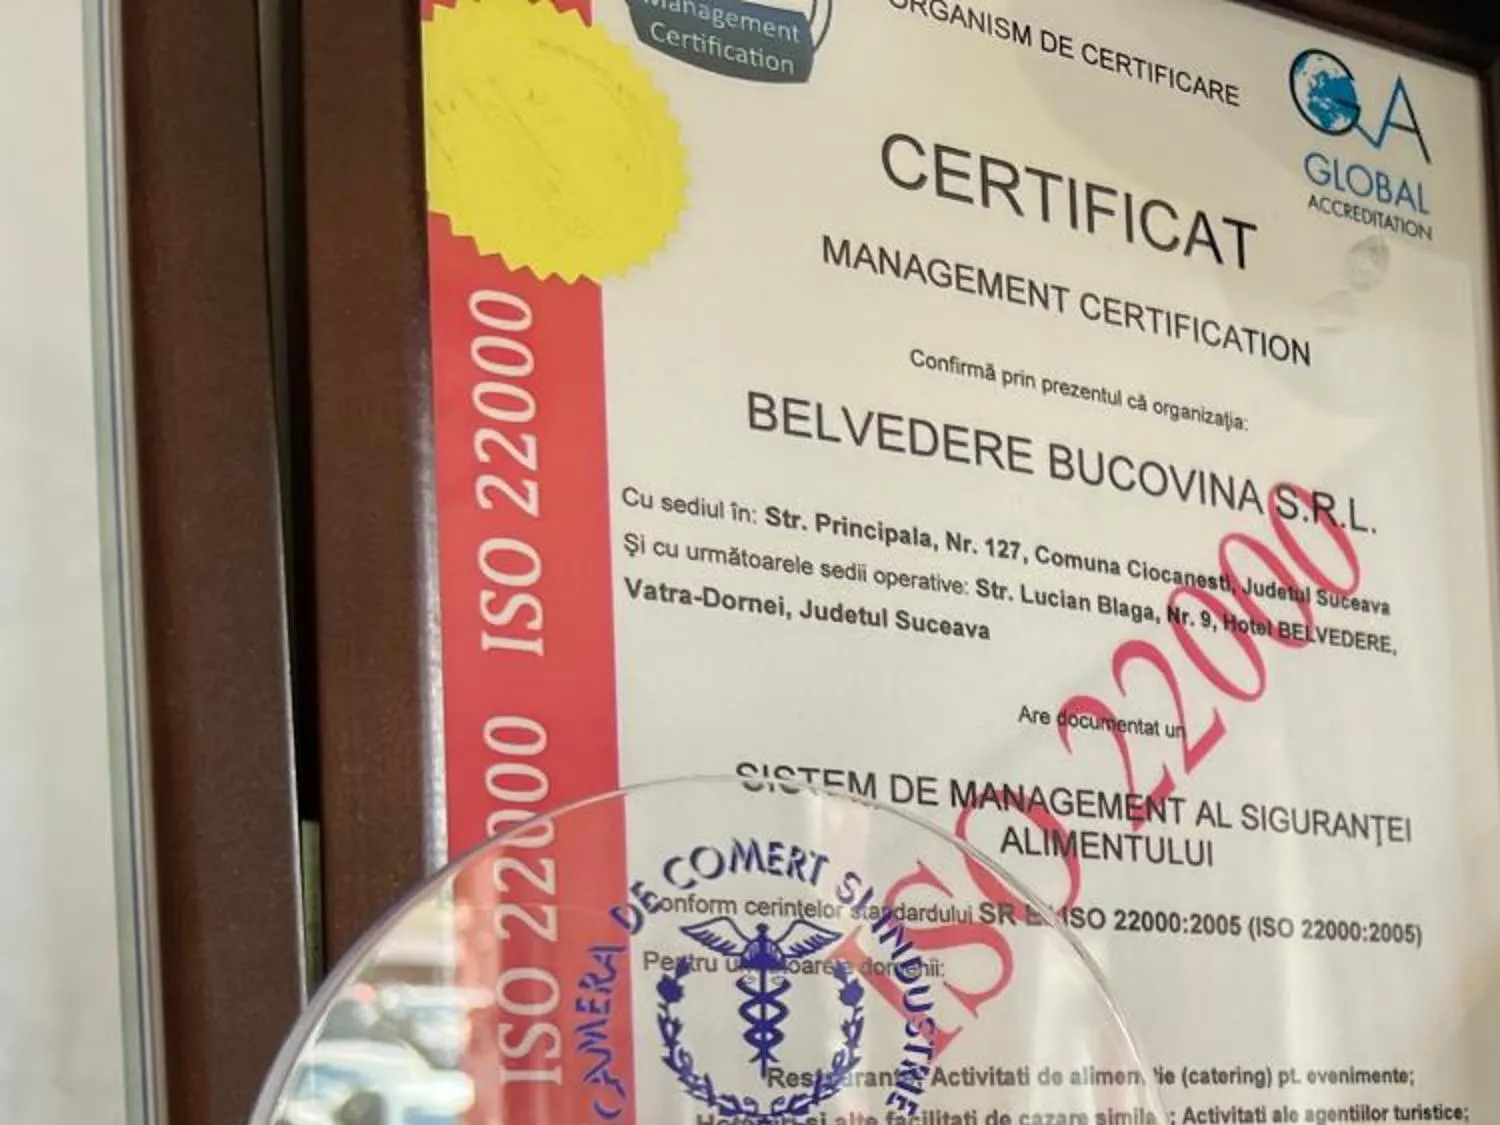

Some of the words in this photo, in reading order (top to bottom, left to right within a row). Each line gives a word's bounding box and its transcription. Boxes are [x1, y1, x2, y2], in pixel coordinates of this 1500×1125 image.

[650, 21, 796, 76] Certification
[1040, 29, 1074, 59] DE
[1082, 42, 1241, 107] CERTIFICARE
[881, 132, 1258, 270] CERTIFICAT
[1303, 152, 1431, 216] GLOBAL
[1307, 195, 1434, 242] ACCREDITATION
[822, 234, 1070, 313] MANAGEMENT
[1080, 291, 1312, 367] CERTIFICATION
[468, 287, 542, 520] 22000
[909, 348, 995, 382] Confirmă
[1001, 368, 1036, 390] prin
[1041, 378, 1122, 407] prezentul
[1126, 393, 1148, 412] că
[747, 390, 1034, 476] BELVEDERE
[1048, 442, 1265, 515] BUCOVINA
[1275, 482, 1378, 535] S.R.L.
[620, 486, 653, 510] Cu
[660, 495, 725, 520] sediul
[764, 506, 809, 531] Str.
[815, 512, 939, 551] Principala,
[945, 531, 978, 555] Nr.
[984, 539, 1029, 565] 127,
[1034, 545, 1121, 576] Comuna
[1242, 577, 1310, 604] Judetul
[1315, 590, 1391, 616] Suceava
[479, 533, 545, 658] ISO
[624, 577, 793, 621] Vatra-Dornei,
[798, 599, 889, 629] Judetul
[894, 608, 991, 641] Suceava
[652, 540, 679, 559] cu
[686, 544, 814, 576] următoarele
[819, 559, 868, 583] sedii
[873, 568, 969, 596] operative:
[975, 576, 1014, 602] Str.
[1019, 583, 1091, 613] Lucian
[1098, 597, 1161, 626] Blaga,
[1166, 606, 1195, 628] Nr.
[1199, 611, 1218, 633] 9,
[1223, 613, 1273, 637] Hotel
[1278, 621, 1397, 655] BELVEDERE,
[1058, 480, 1361, 832] 22000
[1017, 704, 1052, 726] Are
[1056, 706, 1161, 737] documentat
[1164, 723, 1187, 739] un
[484, 714, 560, 944] 22000
[735, 761, 878, 803] SISTEM
[890, 774, 939, 807] DE
[949, 779, 1187, 825] MANAGEMENT
[1195, 801, 1232, 829] AL
[999, 825, 1214, 867] ALIMENTULUI
[648, 893, 738, 916] onform
[979, 902, 1017, 926] SR
[1061, 906, 1106, 930] ISO
[1114, 909, 1242, 937] 22000:2005
[1248, 915, 1295, 943] (ISO
[1301, 918, 1423, 948] 22000:2005)
[496, 965, 563, 1087] ISO
[930, 1066, 1030, 1088] Activitati
[1037, 1067, 1063, 1086] de
[1181, 1066, 1273, 1089] (catering)
[1305, 1067, 1415, 1087] evenimente;
[1271, 1106, 1300, 1125] ale
[1393, 1103, 1470, 1124] turistice;
